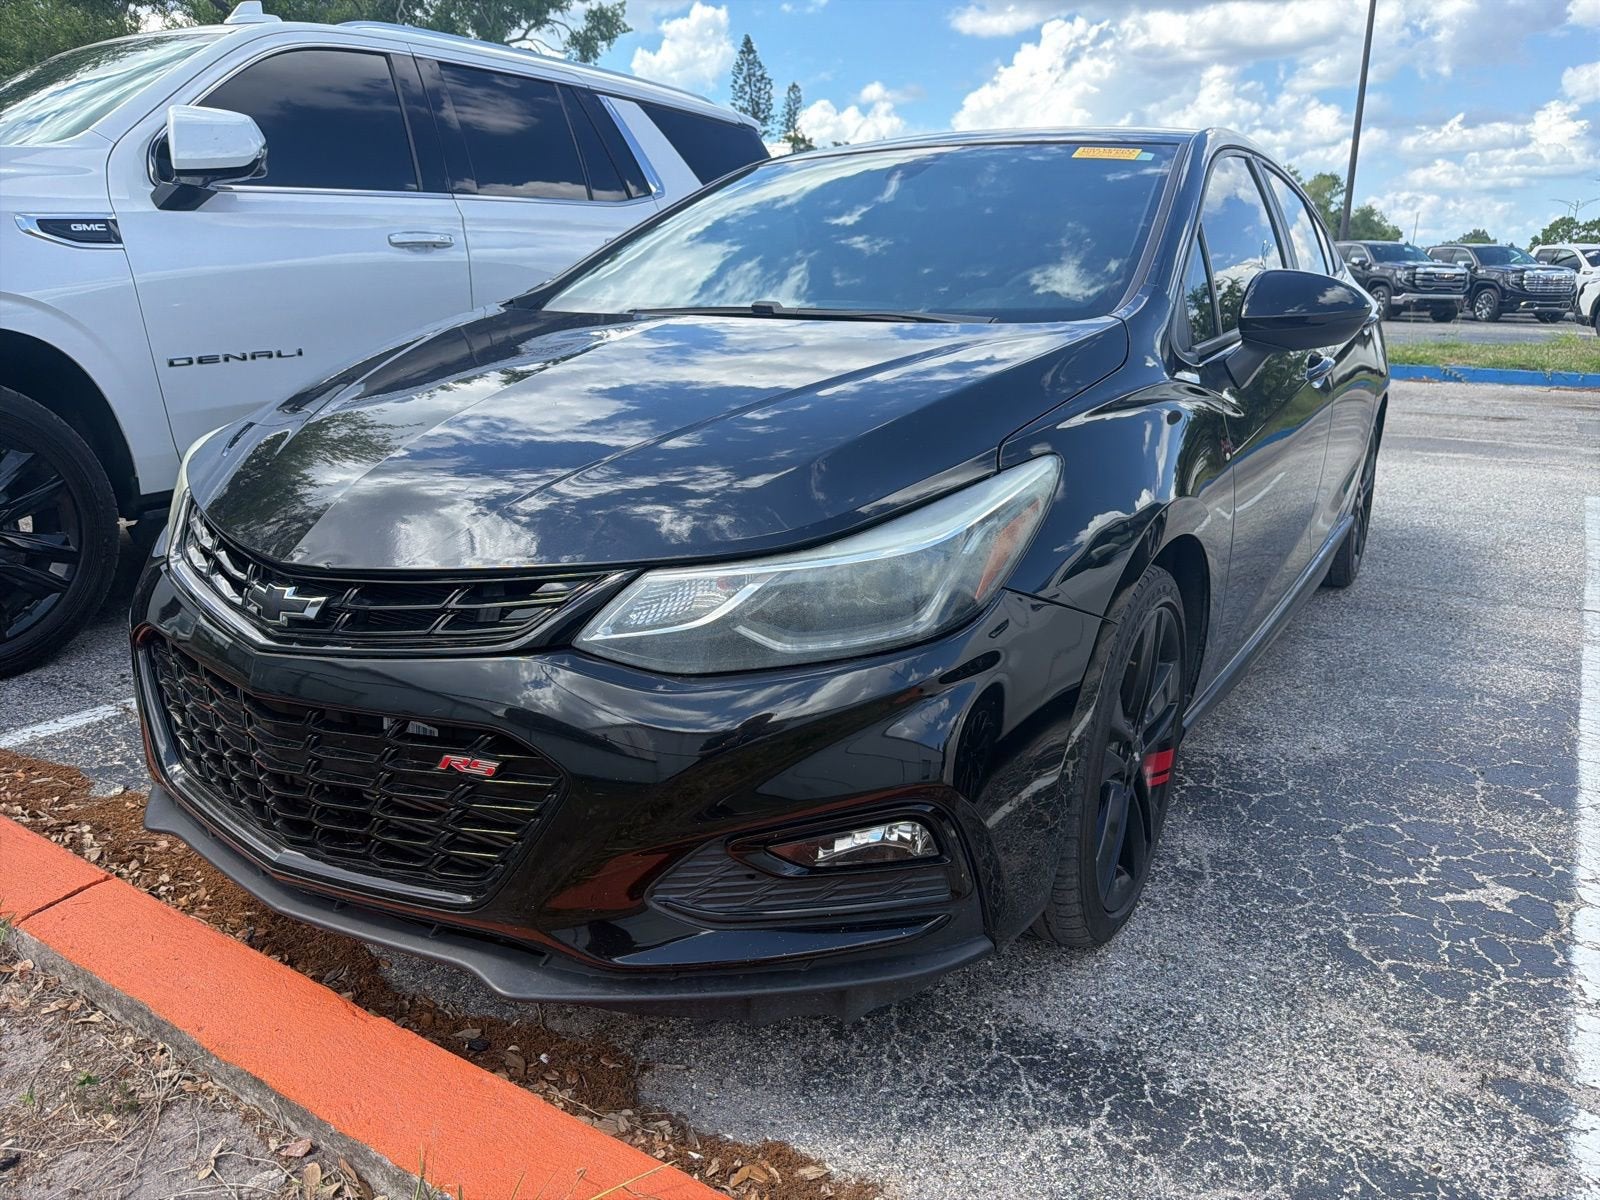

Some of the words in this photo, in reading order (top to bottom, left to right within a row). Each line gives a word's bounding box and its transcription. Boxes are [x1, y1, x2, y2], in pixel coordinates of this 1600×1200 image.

[70, 223, 107, 231] GMC
[167, 348, 303, 367] DENALI
[436, 755, 499, 776] RS
